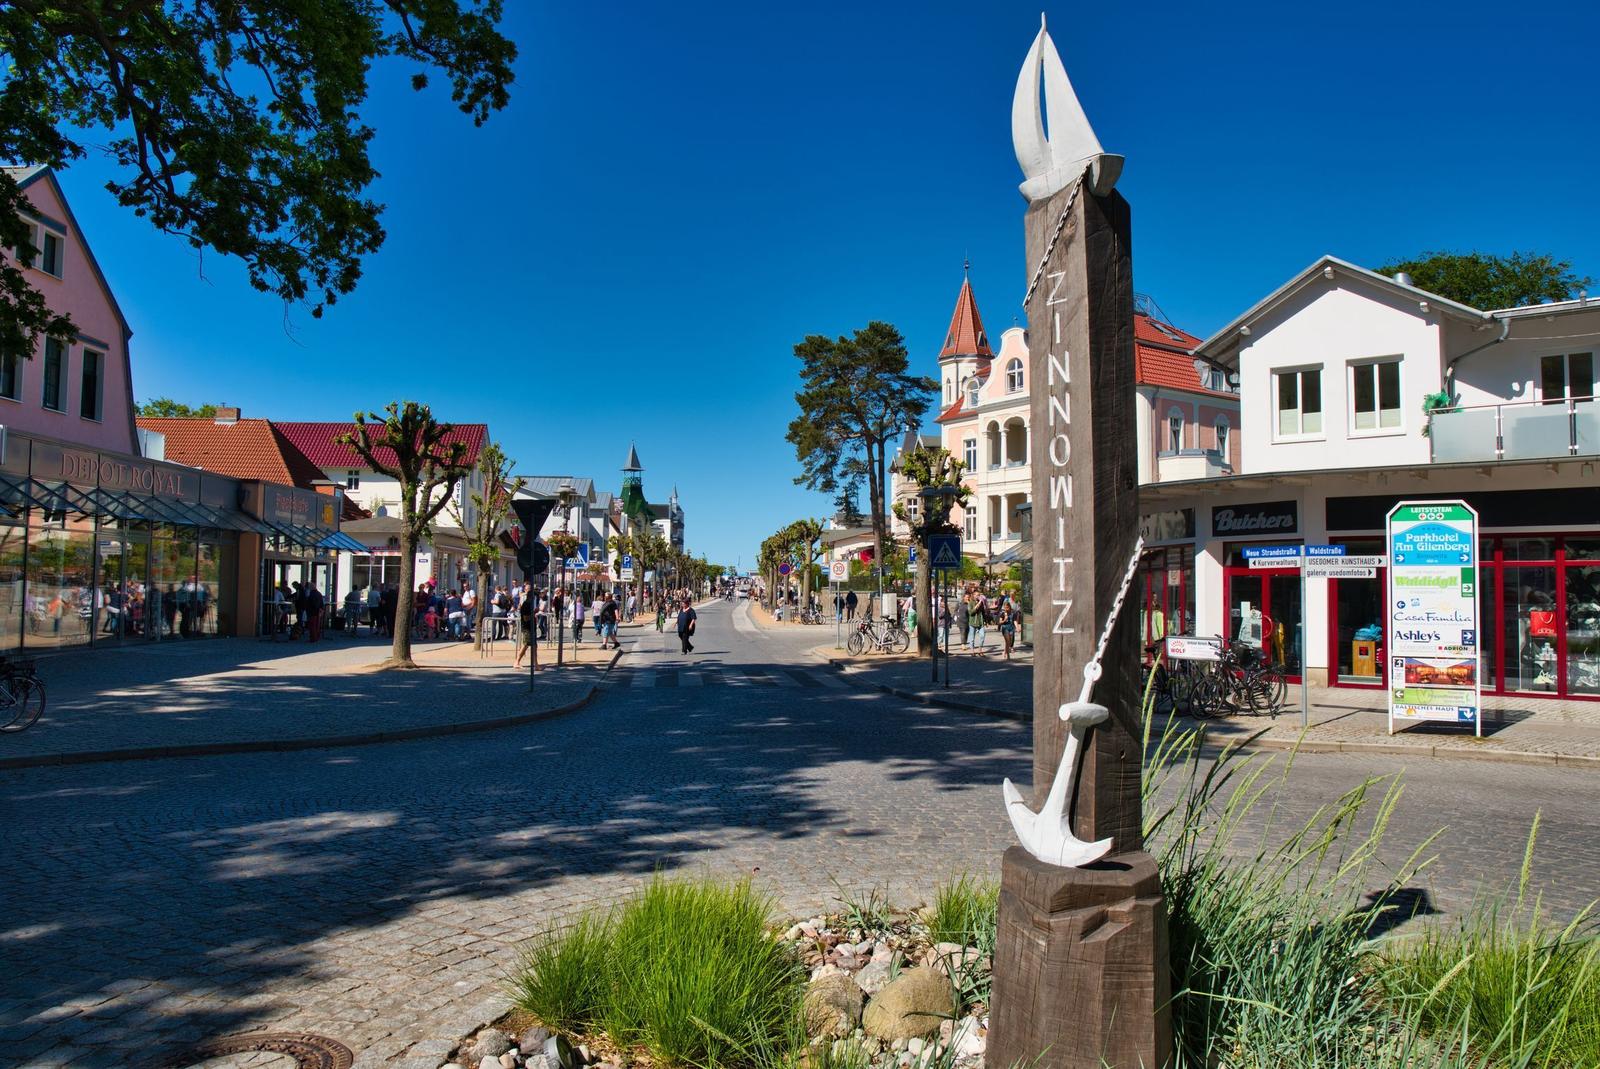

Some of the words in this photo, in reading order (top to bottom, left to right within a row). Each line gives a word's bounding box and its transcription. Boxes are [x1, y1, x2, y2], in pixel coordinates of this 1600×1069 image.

[1046, 271, 1075, 634] ZINNOWITZ
[60, 453, 126, 484] DEPOT
[130, 466, 184, 497] ROYAL
[1215, 509, 1294, 531] Butchers
[1406, 533, 1459, 542] Parkhotel
[1309, 547, 1342, 555] Waldstraße
[1395, 542, 1414, 551] Am
[1416, 541, 1470, 553] Glienberg
[1261, 548, 1297, 556] Strandstraße
[623, 556, 630, 565] P
[1257, 559, 1298, 567] Kurverwaltung
[1341, 557, 1376, 565] KUNSTHAUS
[1306, 569, 1327, 577] galerie
[1328, 568, 1366, 576] usedomfotos
[1394, 630, 1441, 643] Ashley's
